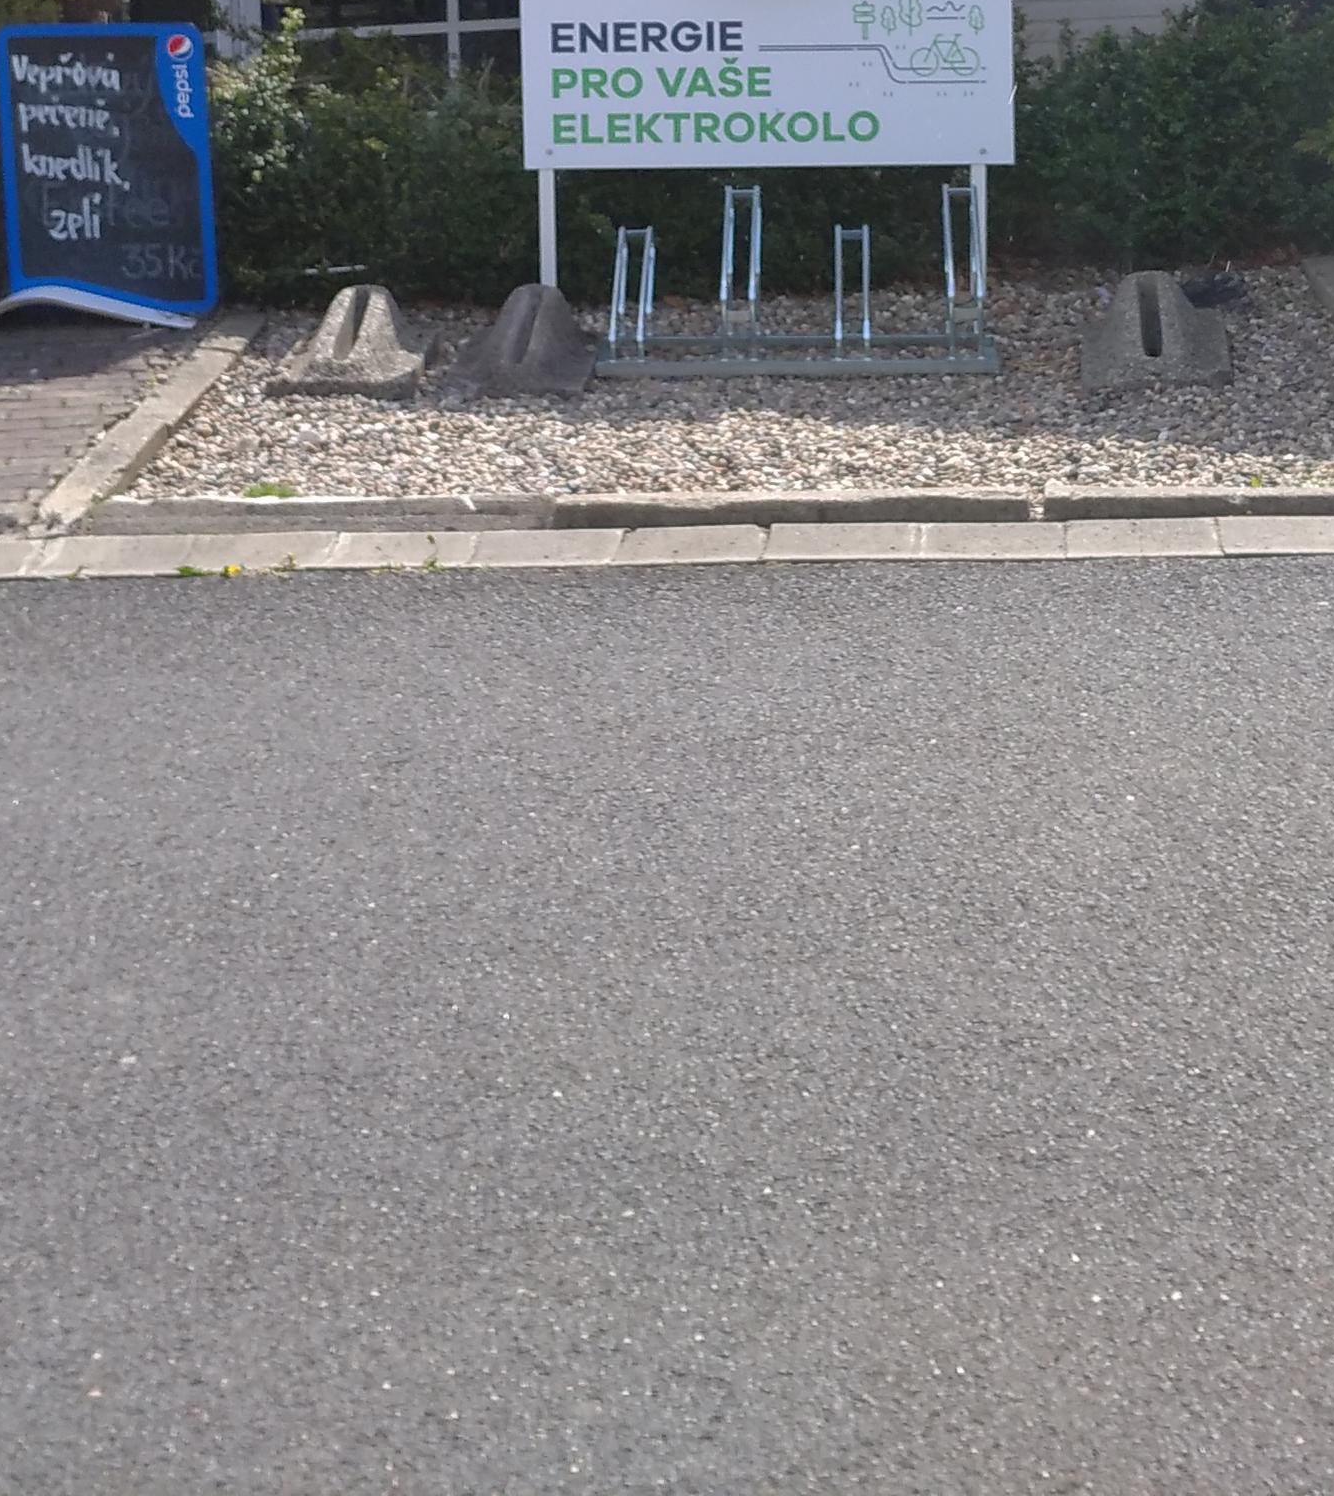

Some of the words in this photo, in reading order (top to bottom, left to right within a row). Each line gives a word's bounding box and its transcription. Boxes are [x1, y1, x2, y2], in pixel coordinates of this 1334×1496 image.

[550, 20, 744, 53] ENERGIE
[172, 63, 195, 119] pepsi
[551, 67, 643, 99] PRO
[656, 57, 773, 98] VAŠE
[552, 110, 881, 145] ELEKTROKOLO
